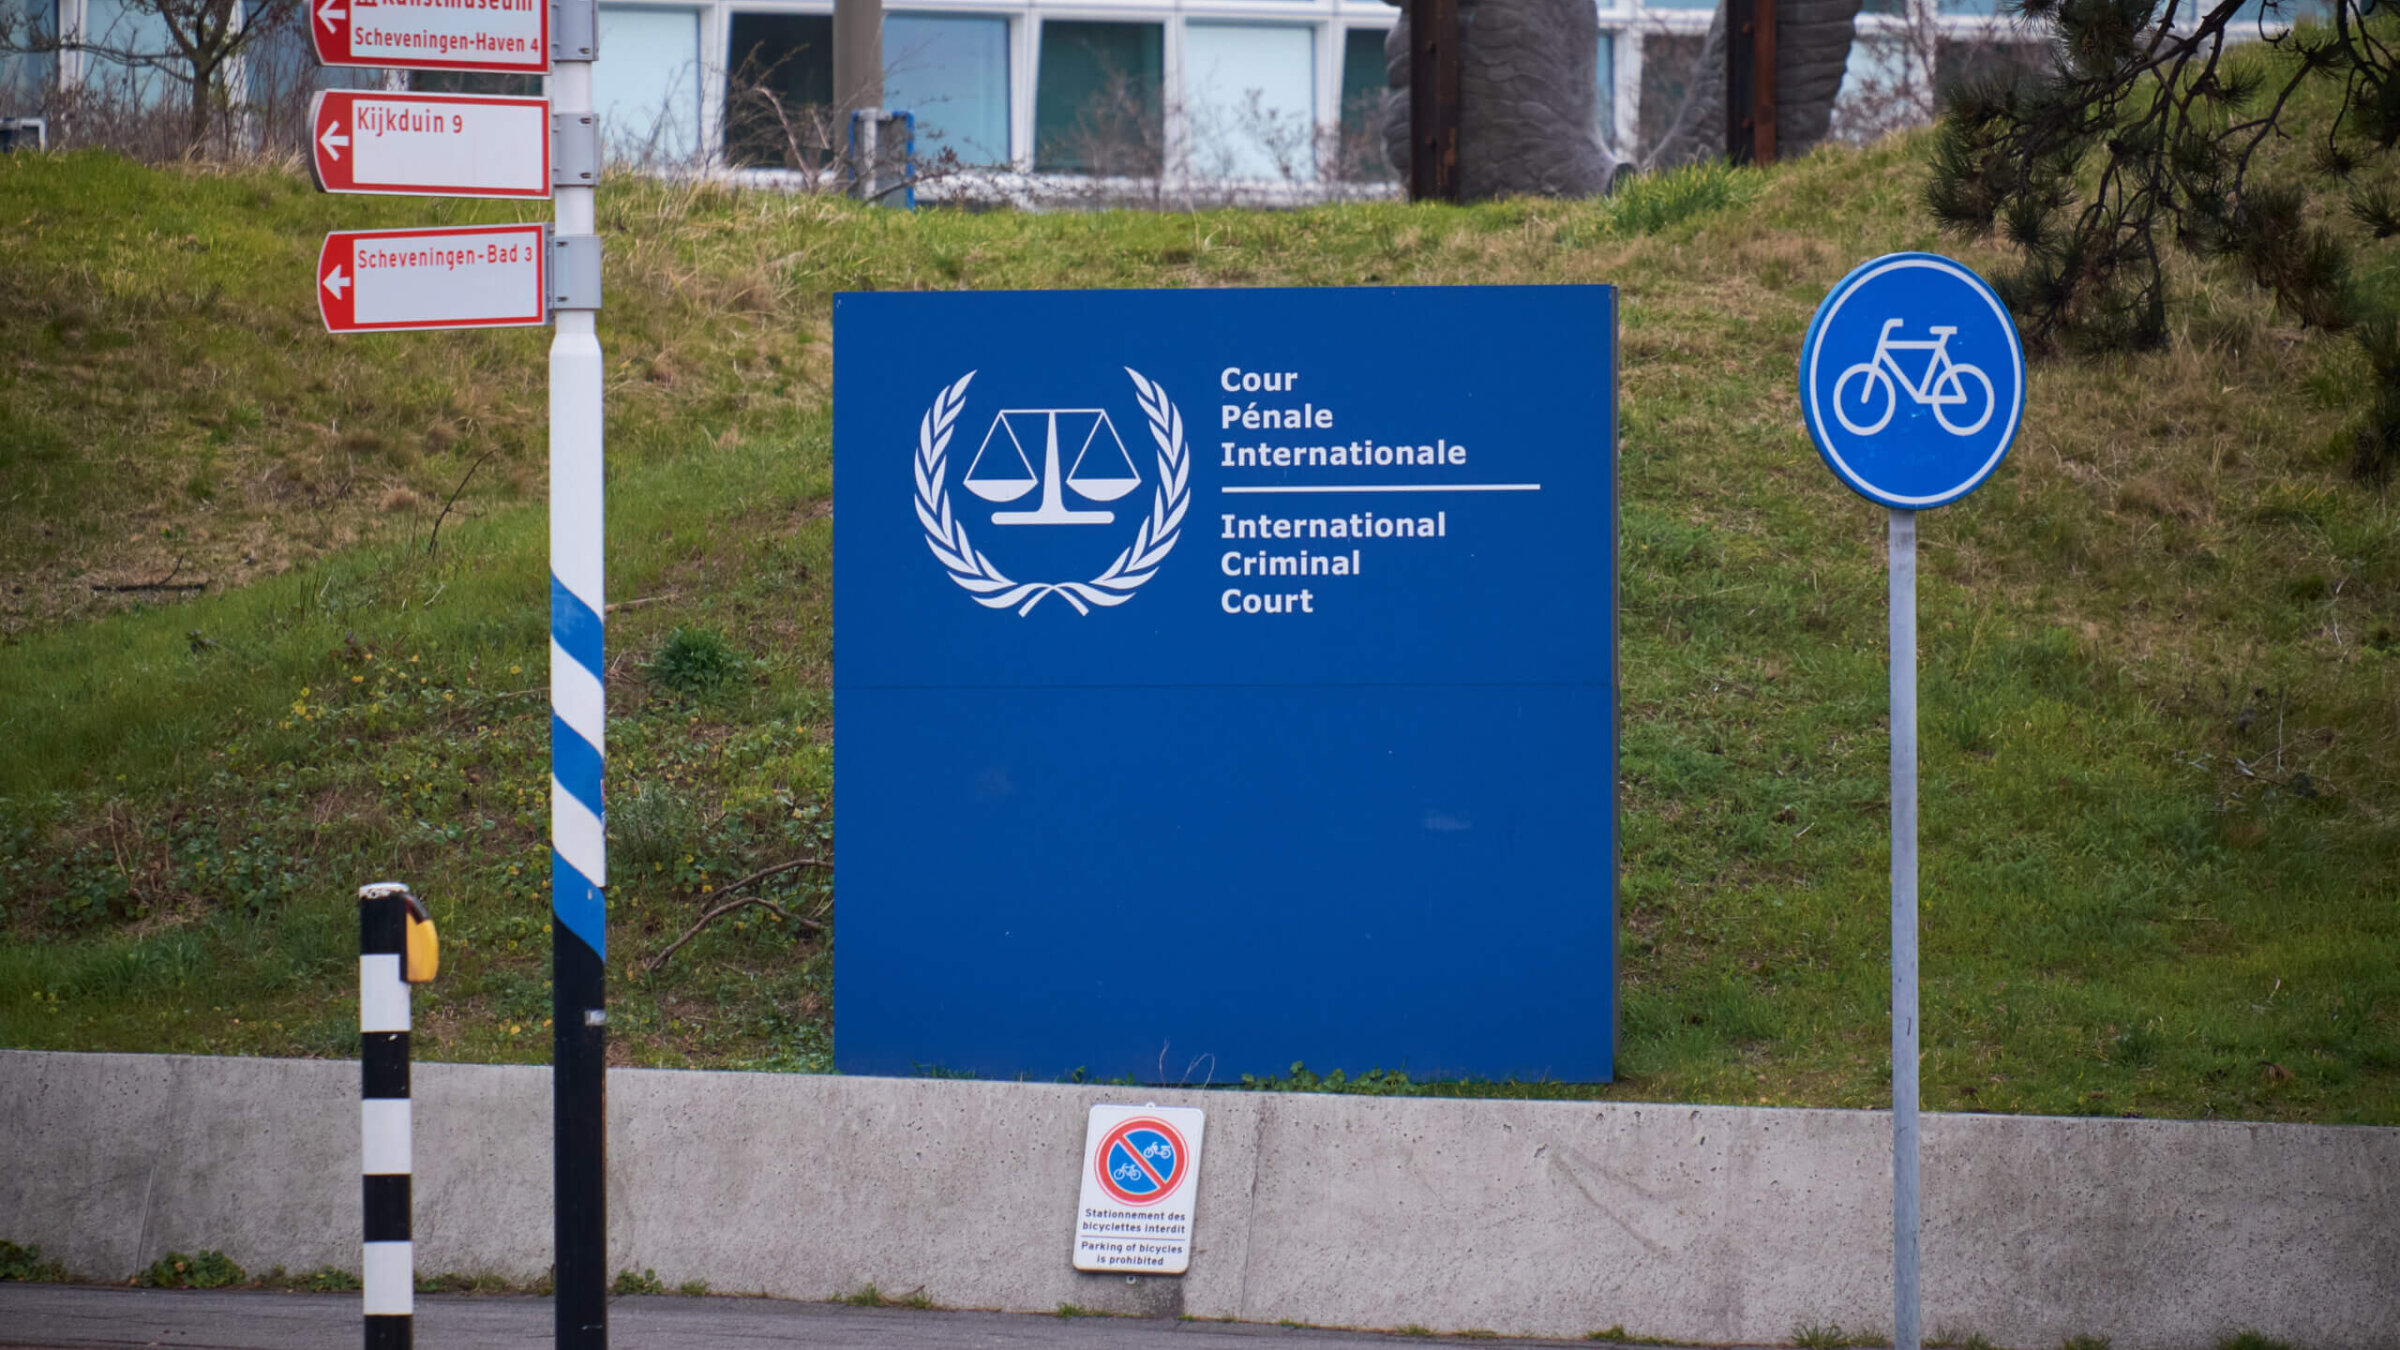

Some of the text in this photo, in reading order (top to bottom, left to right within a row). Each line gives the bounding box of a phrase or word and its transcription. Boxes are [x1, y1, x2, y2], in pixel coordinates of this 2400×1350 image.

[355, 27, 539, 54] Scheveningen-Haven 4
[357, 107, 463, 137] Kijkduin 9
[357, 244, 533, 270] Scheveningen-Bad 3
[1221, 367, 1298, 392] Cour
[1222, 402, 1333, 429] Pénale
[1221, 440, 1467, 466] Internationale
[1221, 512, 1446, 538] International
[1221, 550, 1360, 576] Criminal
[1221, 589, 1313, 613] Court
[1082, 1221, 1185, 1234] bicyclettes interdit
[1085, 1208, 1185, 1221] Stationnement des
[1081, 1241, 1182, 1254] Parking of bicycles
[1096, 1254, 1164, 1266] is prohibited
